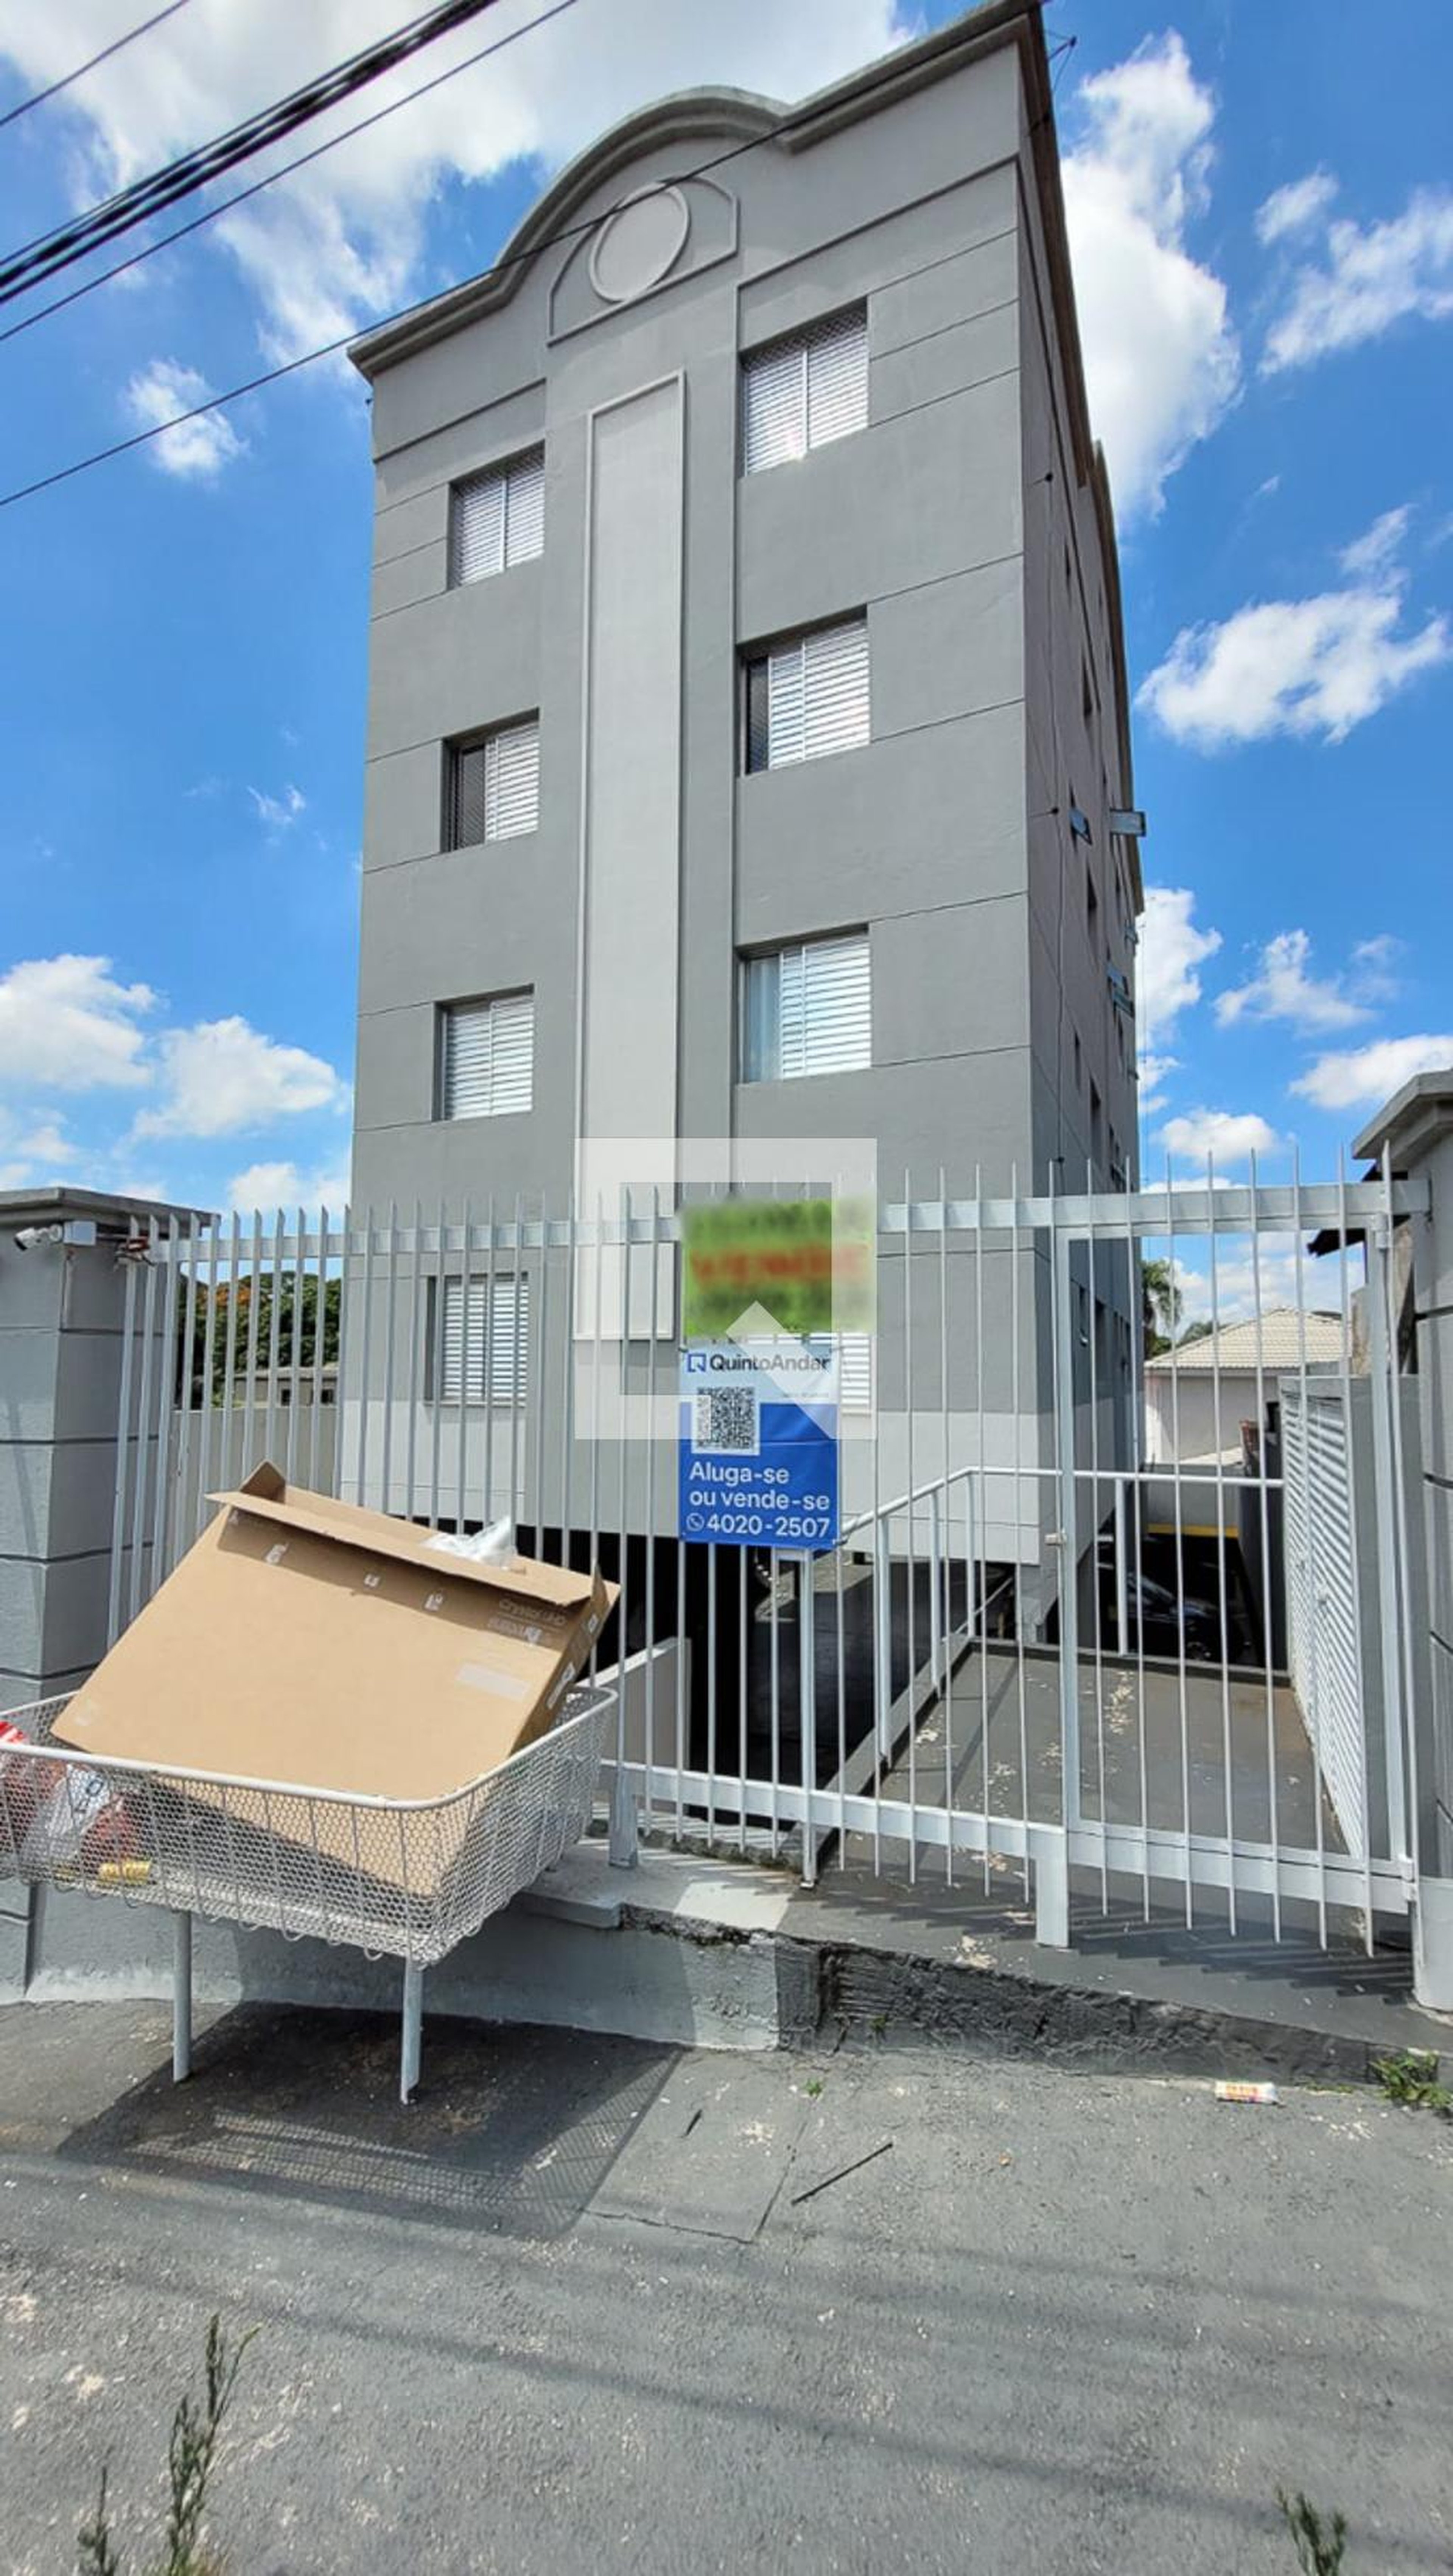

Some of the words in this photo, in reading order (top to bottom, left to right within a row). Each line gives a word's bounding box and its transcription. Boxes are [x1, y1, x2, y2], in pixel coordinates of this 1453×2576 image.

[709, 1354, 830, 1372] QuintoAndar
[689, 1461, 790, 1486] Aluga-se
[689, 1490, 716, 1507] ou
[721, 1490, 830, 1510] vende-se
